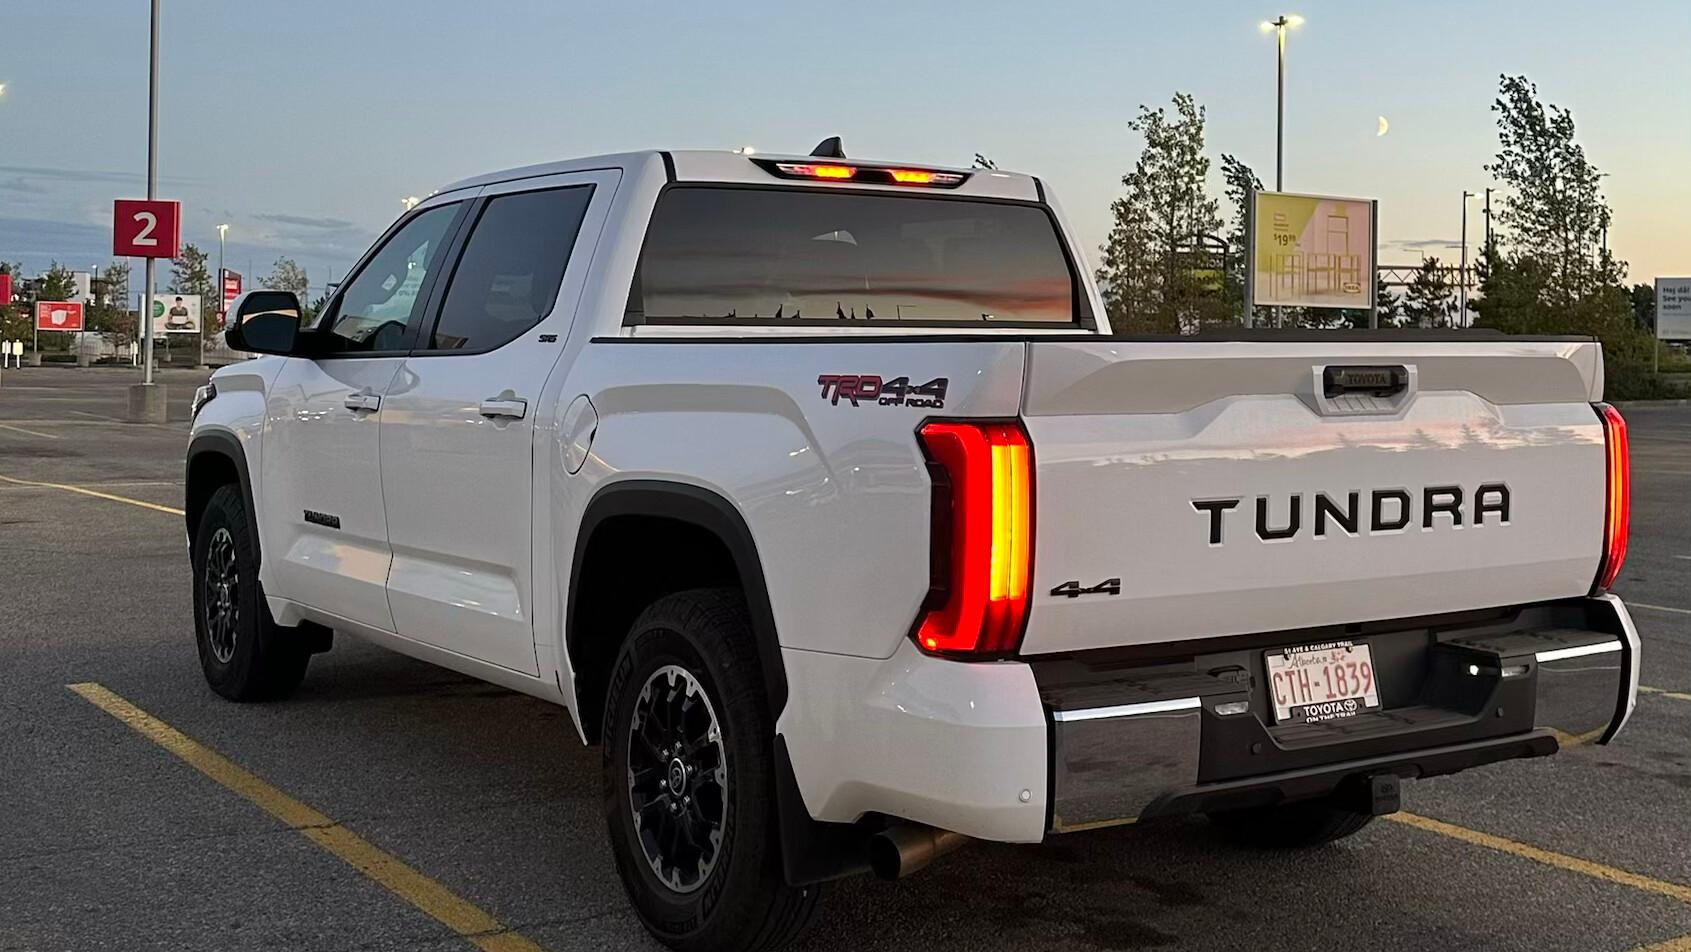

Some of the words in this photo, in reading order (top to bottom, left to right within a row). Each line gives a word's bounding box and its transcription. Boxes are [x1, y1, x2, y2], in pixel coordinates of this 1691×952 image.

[132, 211, 158, 246] 2
[1347, 373, 1386, 384] TOYOTA
[817, 374, 883, 408] TRD
[881, 376, 949, 401] 4x4
[878, 396, 905, 406] OFF
[905, 398, 944, 408] ROAD
[1190, 482, 1512, 546] TUNDRA
[1310, 642, 1336, 651] CALGARY
[1273, 661, 1372, 705] CTH-1839
[1303, 701, 1344, 716] TOYOTA
